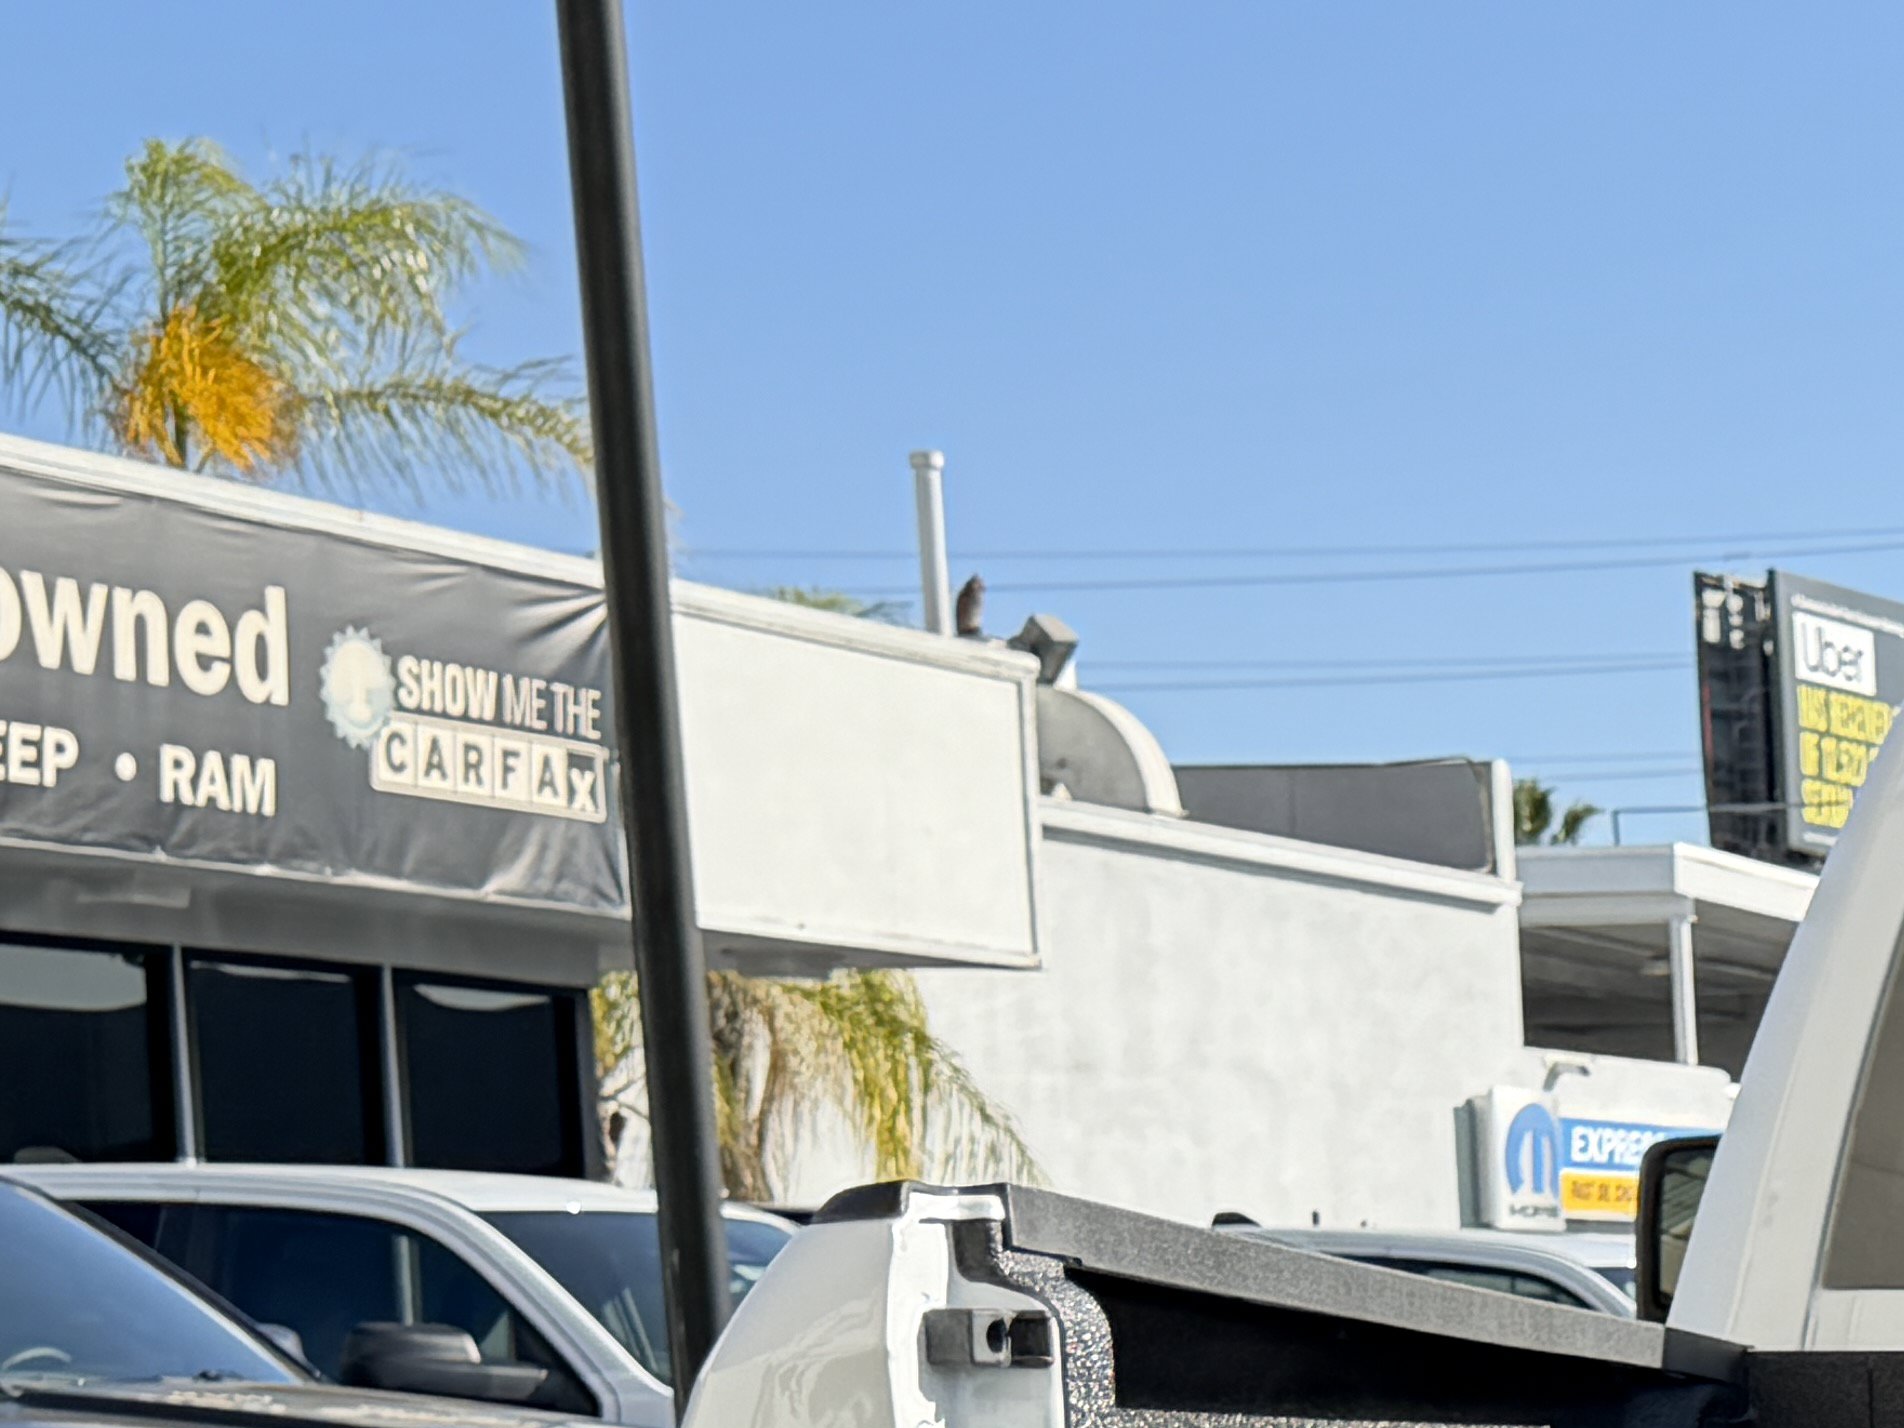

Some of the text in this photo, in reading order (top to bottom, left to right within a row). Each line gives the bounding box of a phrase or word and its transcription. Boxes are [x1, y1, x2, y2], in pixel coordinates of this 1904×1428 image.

[1800, 621, 1864, 683] Uber
[397, 655, 602, 740] SHOW ME THE
[0, 719, 276, 818] EP RAM
[385, 730, 600, 813] CARFAX
[1571, 1125, 1665, 1165] EXPRE
